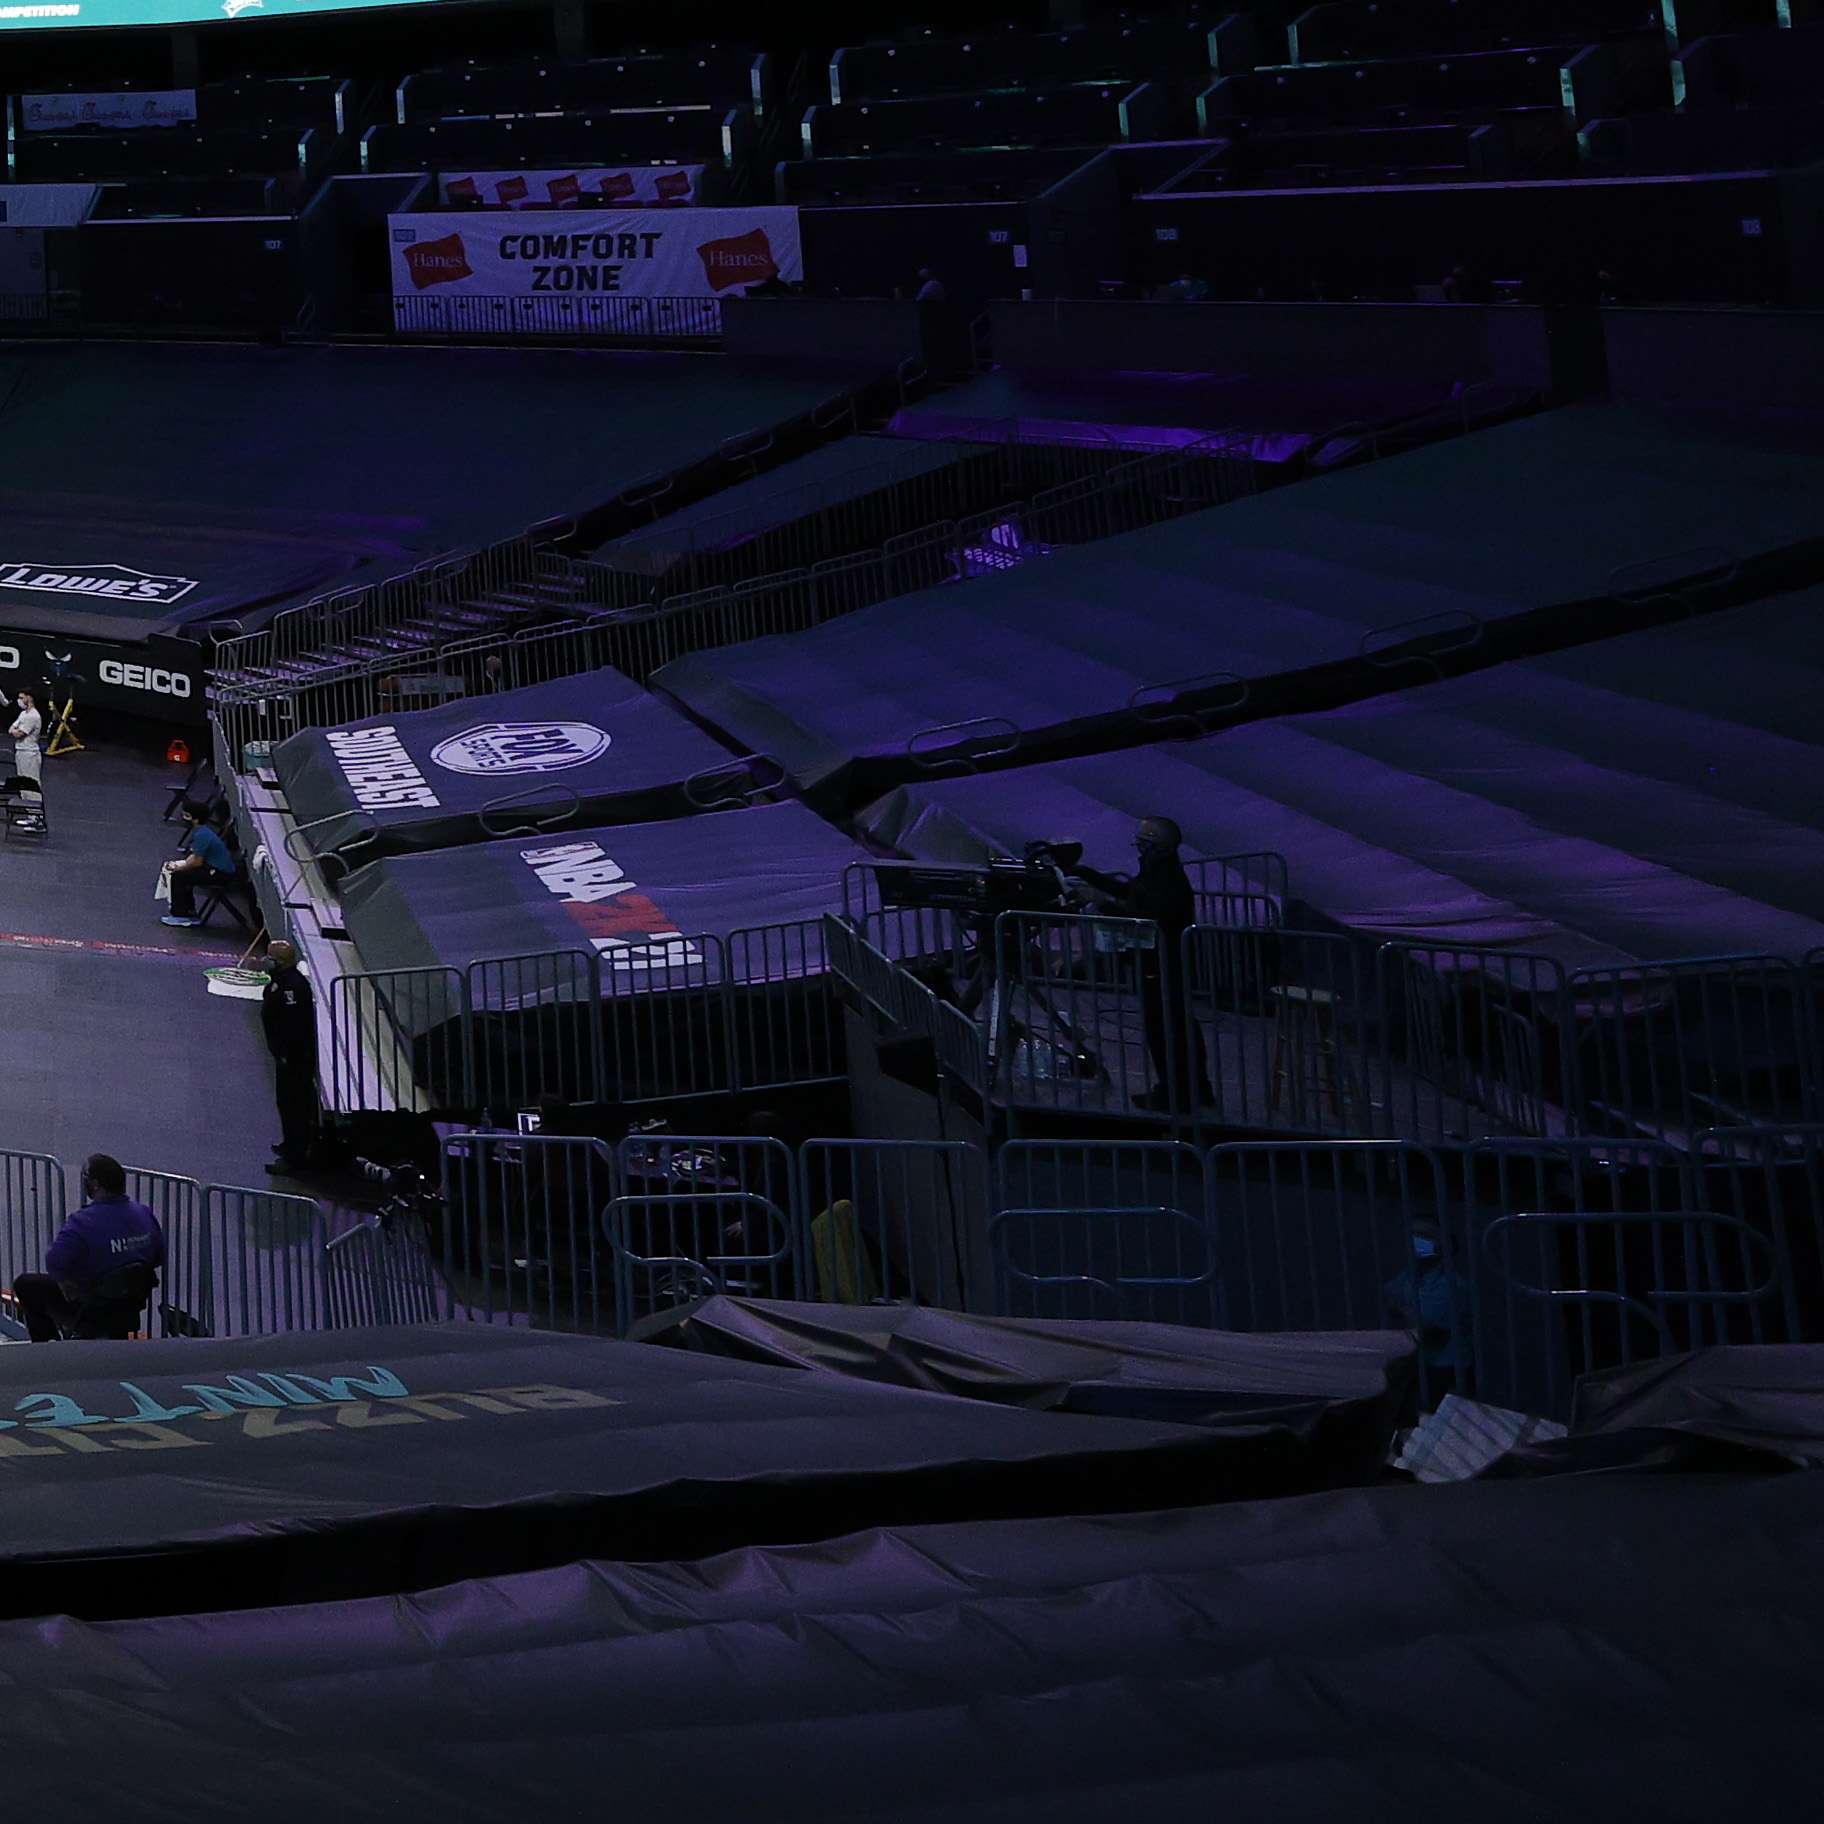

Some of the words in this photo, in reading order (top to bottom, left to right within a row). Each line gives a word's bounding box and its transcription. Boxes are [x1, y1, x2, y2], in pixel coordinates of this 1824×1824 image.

[413, 251, 463, 268] Hanes
[499, 232, 663, 260] COMFORT
[709, 250, 769, 267] Hanes
[532, 264, 623, 292] ZONE
[3, 567, 169, 598] LOWE'S
[100, 660, 191, 698] GEICO
[325, 726, 440, 811] SOUTHEAST
